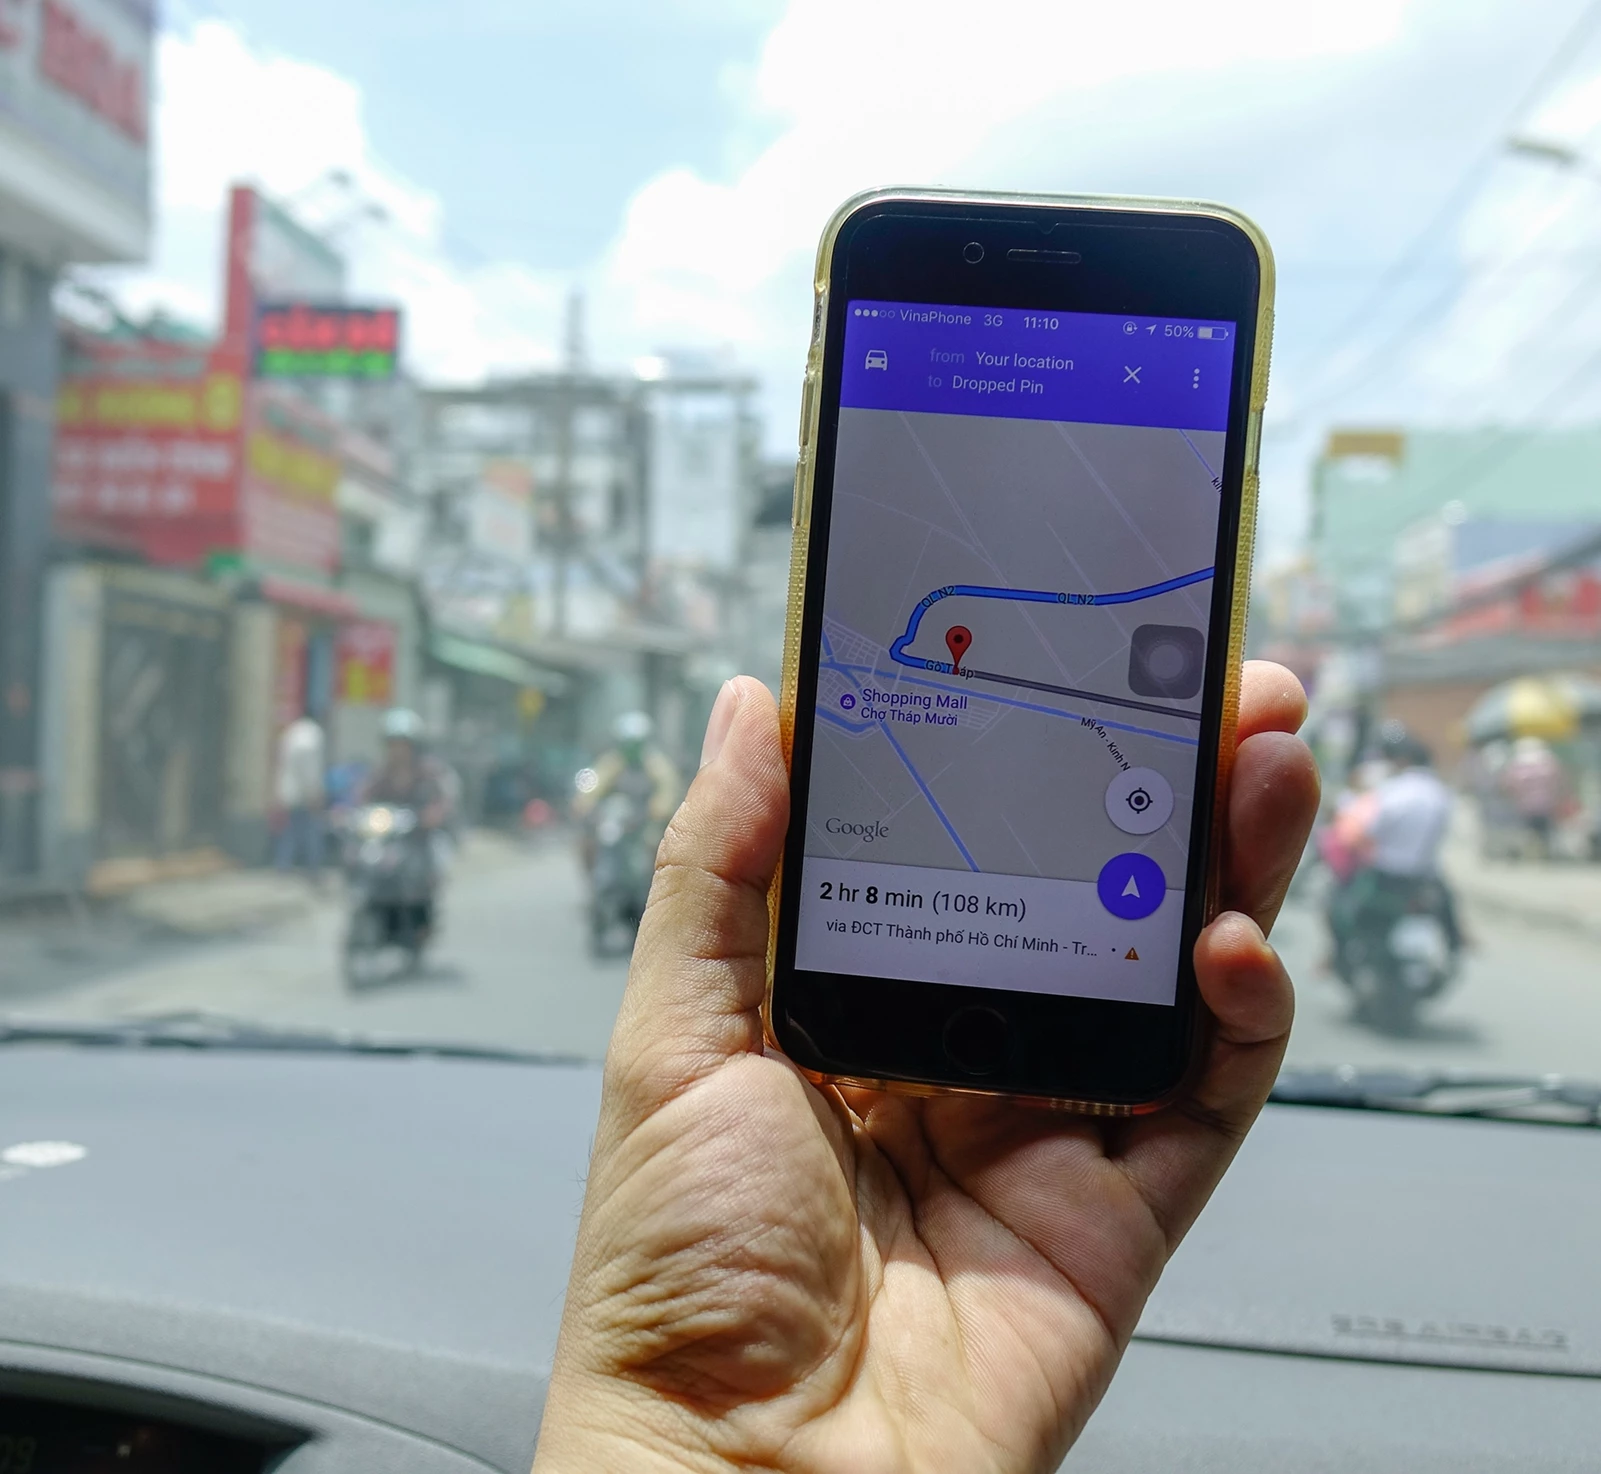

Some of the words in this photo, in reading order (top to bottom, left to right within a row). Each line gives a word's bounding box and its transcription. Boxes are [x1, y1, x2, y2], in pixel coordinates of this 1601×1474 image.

[900, 308, 972, 325] VinaPhone
[983, 314, 1003, 327] 3G
[1023, 316, 1060, 331] 11:10
[1164, 324, 1195, 339] 50%
[930, 347, 965, 364] from
[975, 351, 1010, 367] Your
[1013, 352, 1074, 371] location
[927, 374, 942, 388] to
[952, 375, 1016, 394] Dropped
[1020, 379, 1044, 395] Pin
[937, 585, 955, 599] N2
[1057, 592, 1074, 605] QL
[1077, 593, 1095, 606] N2
[945, 663, 974, 680] Táp
[861, 688, 932, 710] Shopping
[935, 694, 968, 710] Mall
[860, 707, 887, 722] Chợ
[889, 709, 921, 726] Tháp
[924, 712, 958, 726] Mười
[825, 817, 890, 843] Google
[819, 881, 833, 900] 2
[838, 882, 860, 903] hr
[865, 886, 879, 904] 8
[884, 889, 924, 909] min
[932, 890, 979, 915] (108
[985, 896, 1026, 923] km)
[826, 918, 847, 933] via
[851, 920, 883, 936] ĐCT
[886, 923, 932, 941] Thành
[935, 926, 965, 945] phố
[968, 931, 990, 947] Hồ
[993, 933, 1019, 949] Chí
[1022, 936, 1059, 953] Minh
